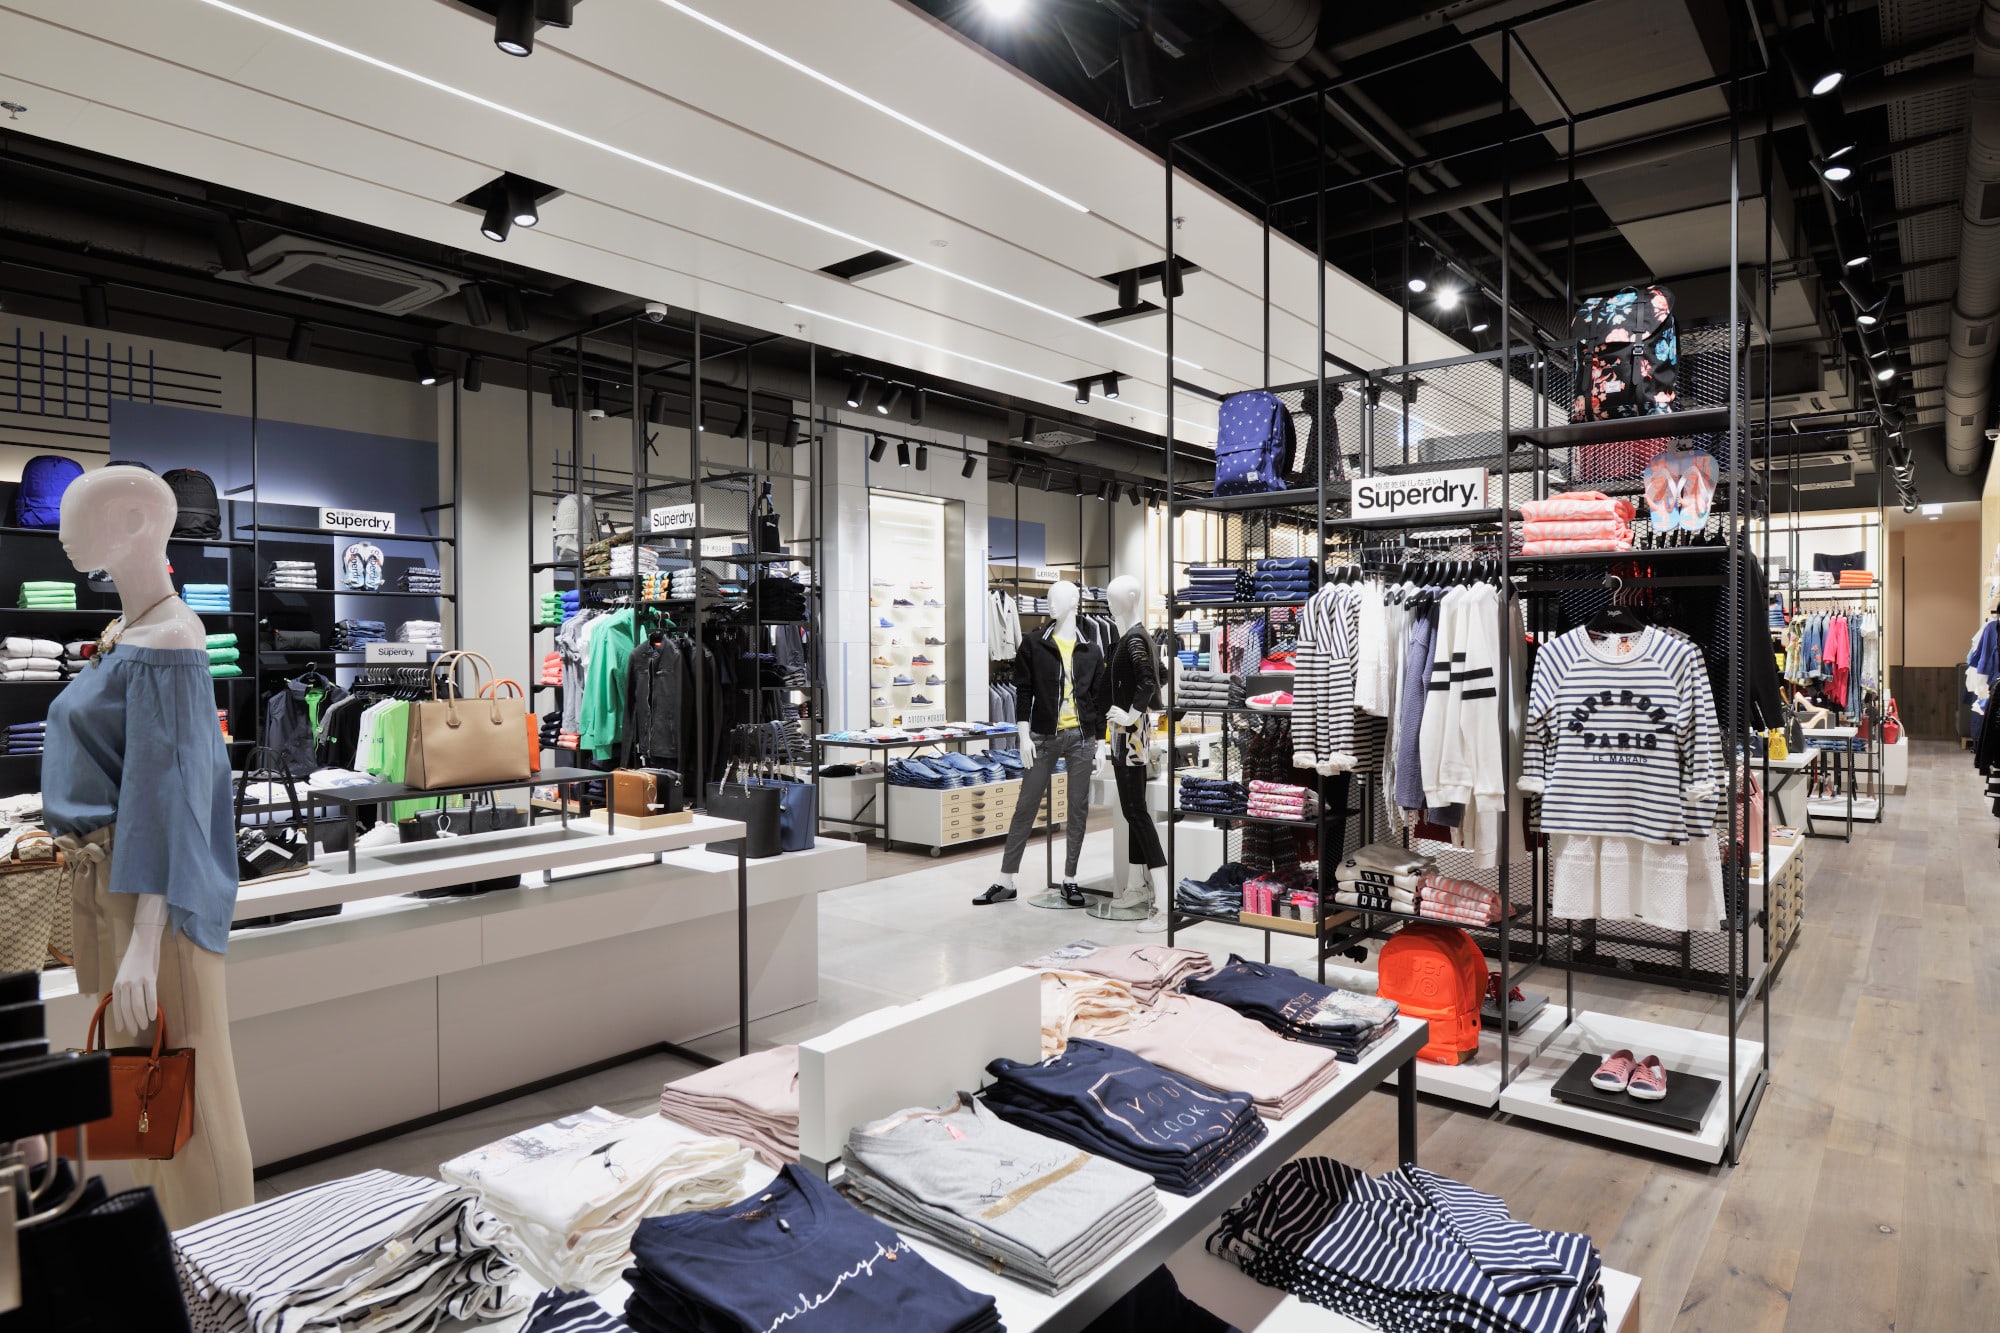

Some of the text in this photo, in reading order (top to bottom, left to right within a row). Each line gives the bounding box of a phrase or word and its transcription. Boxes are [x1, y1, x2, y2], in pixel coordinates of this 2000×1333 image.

[1358, 480, 1478, 512] Superdry.
[326, 512, 392, 531] Superdry.
[1584, 733, 1657, 750] PARIS
[1609, 755, 1648, 763] MARAIS
[1364, 872, 1390, 885] DRY
[1358, 883, 1385, 896] DRY
[1360, 895, 1388, 909] DRY
[1127, 1085, 1180, 1114] YOU
[1151, 1104, 1210, 1140] LOOK
